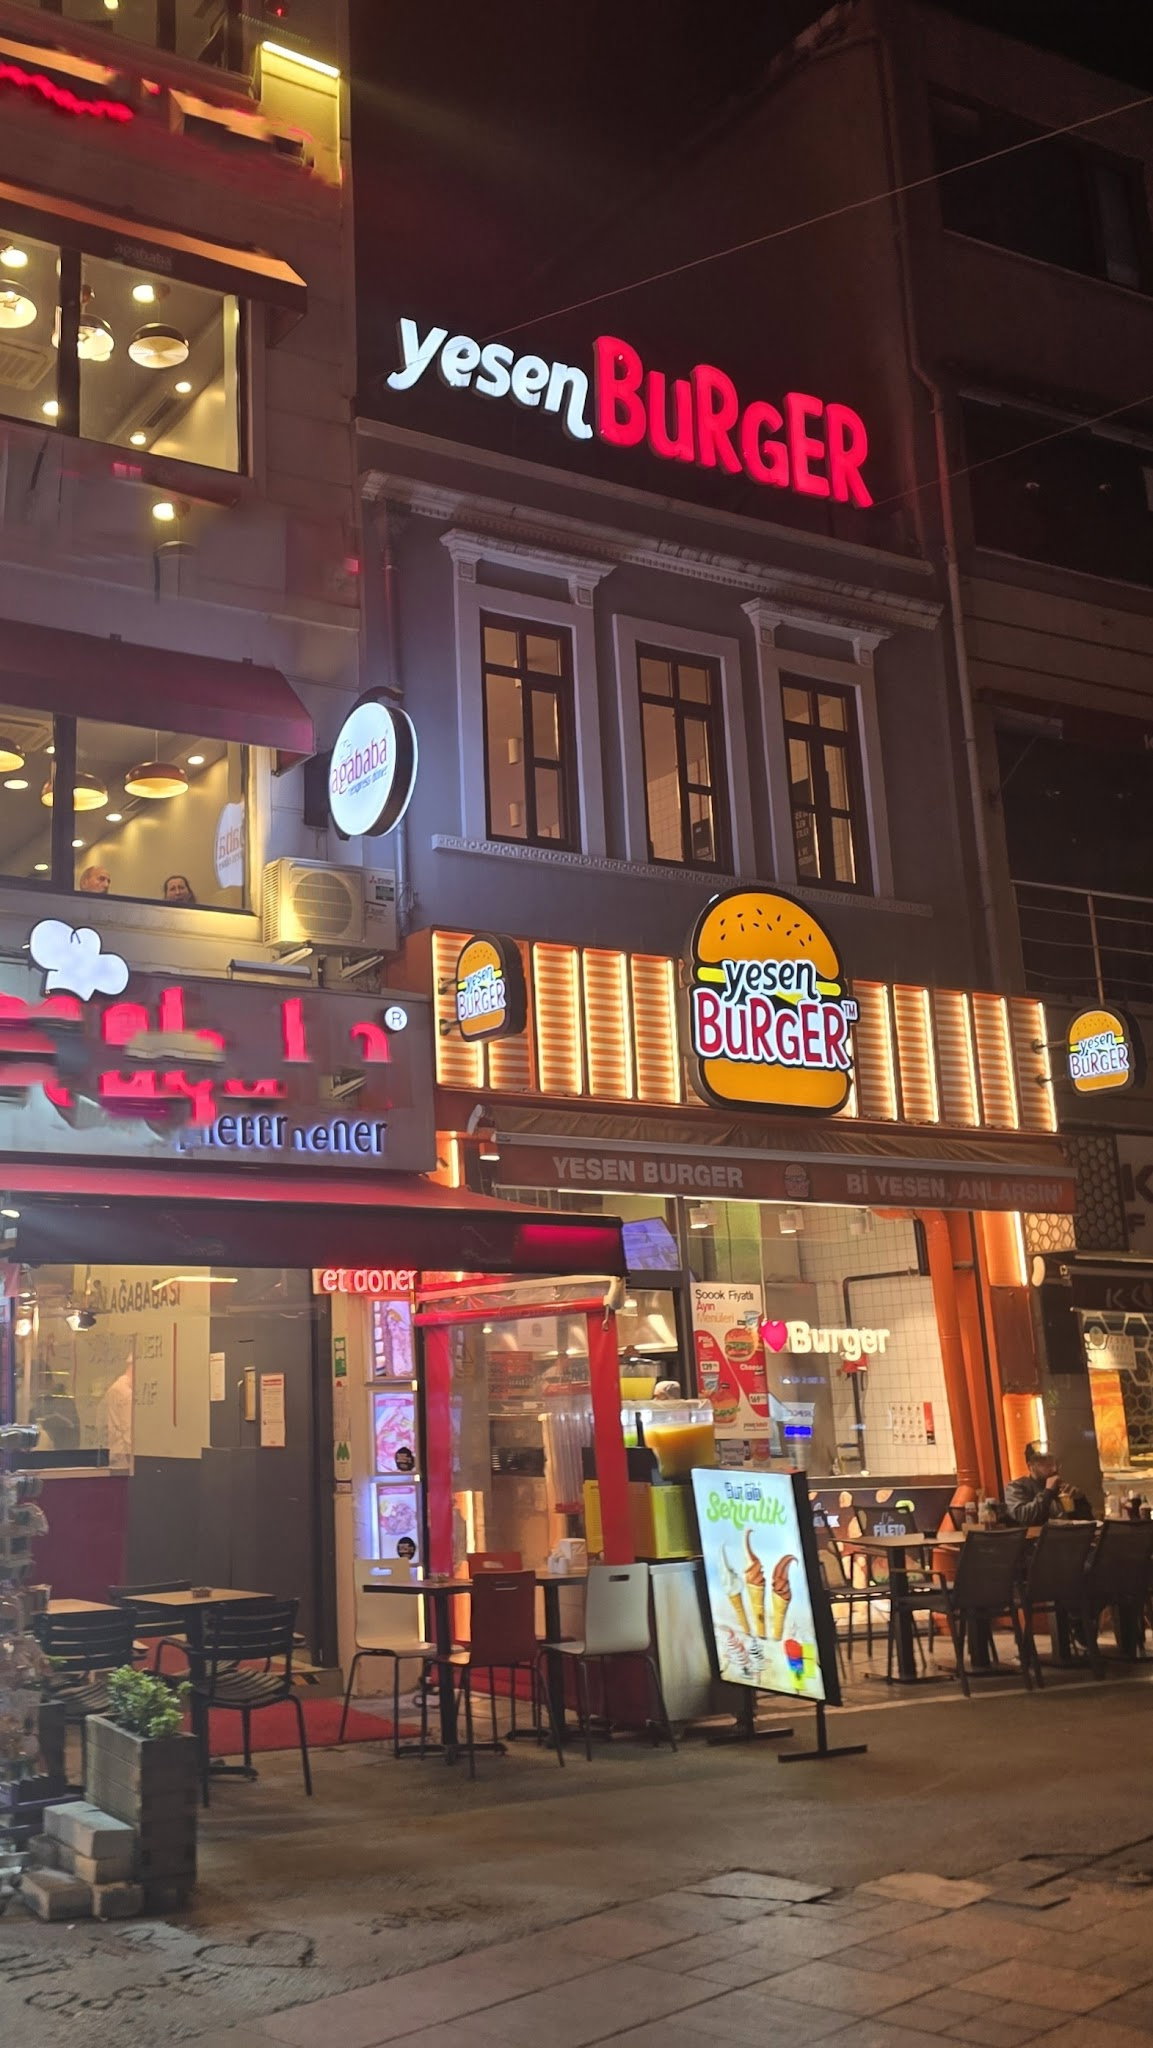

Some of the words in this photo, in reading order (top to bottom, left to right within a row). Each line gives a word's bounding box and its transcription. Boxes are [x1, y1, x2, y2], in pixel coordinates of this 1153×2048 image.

[386, 317, 594, 440] yesen
[723, 963, 820, 1002] yesen
[1079, 1032, 1116, 1057] yesen
[552, 1156, 636, 1183] YESEN
[643, 1161, 745, 1188] BURGER
[786, 1320, 890, 1362] Burger
